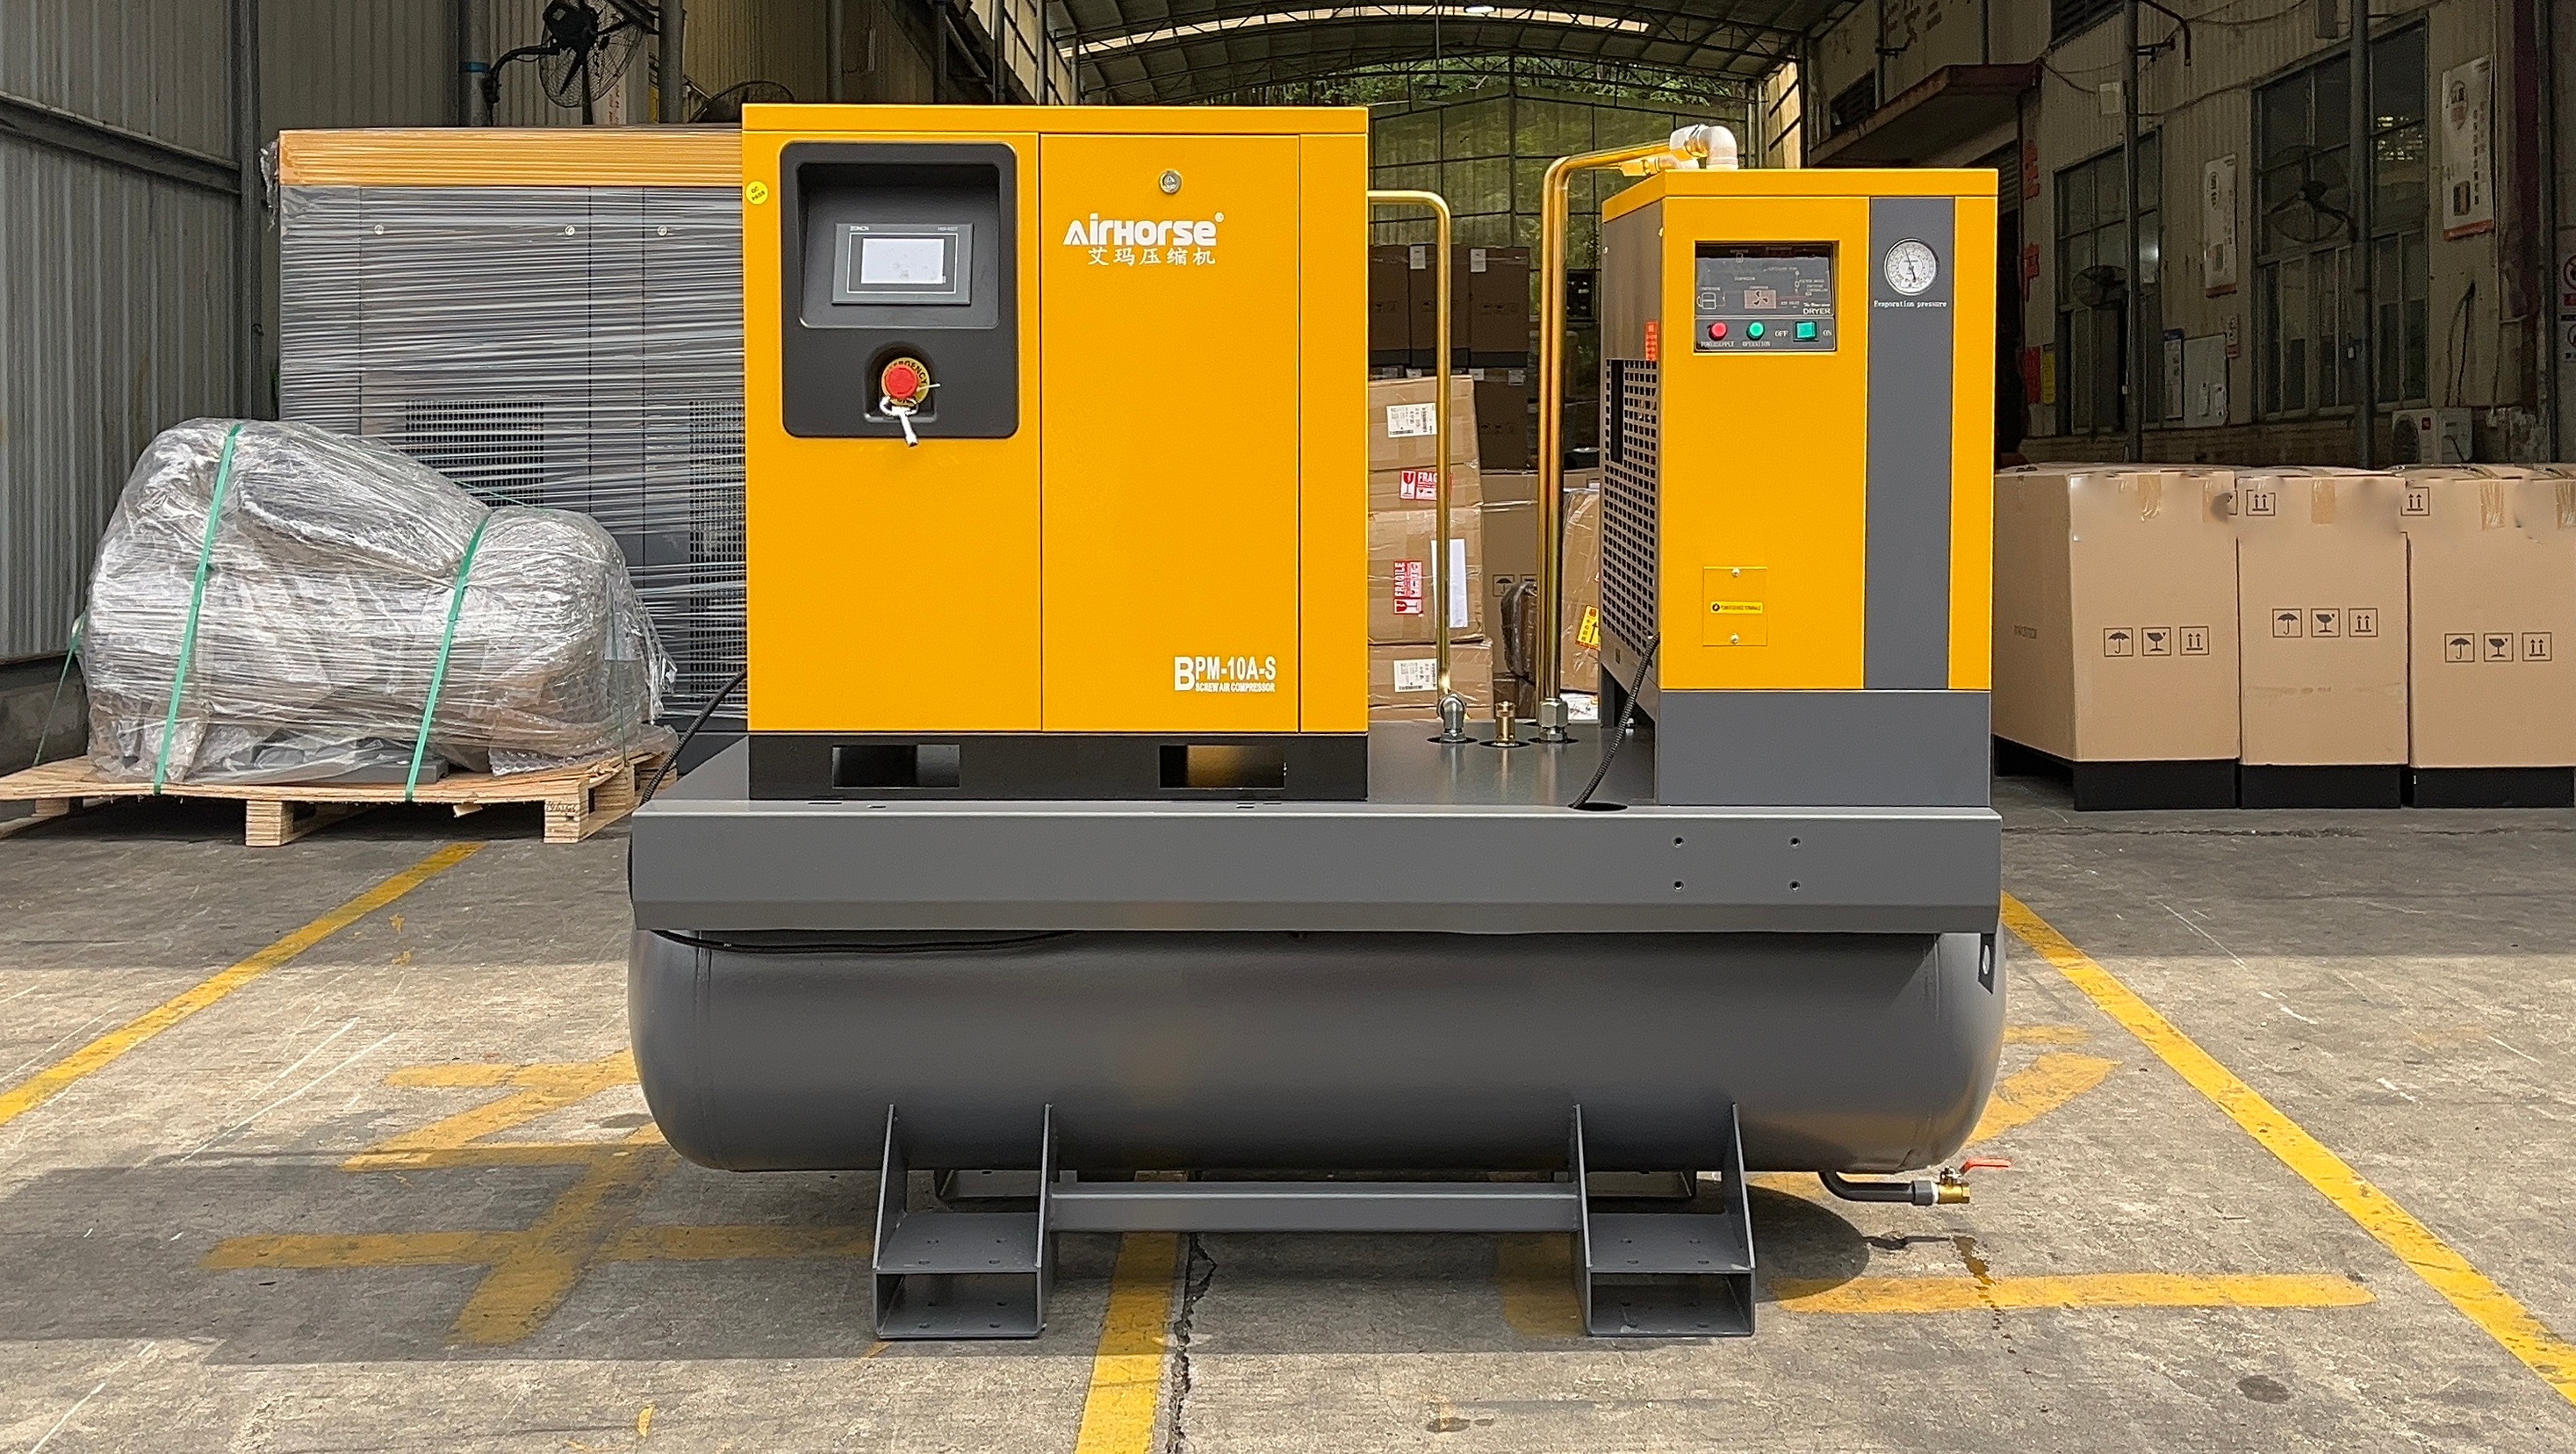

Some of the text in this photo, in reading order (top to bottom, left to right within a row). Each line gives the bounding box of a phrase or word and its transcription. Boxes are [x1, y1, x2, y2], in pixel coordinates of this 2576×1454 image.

[752, 191, 766, 200] PASS
[1088, 247, 1216, 266] 艾玛压缩机
[1418, 471, 1437, 483] FRAG
[1394, 562, 1406, 597] FRAGILE
[1195, 682, 1276, 692] SCREW AIR COMPRESSOR
